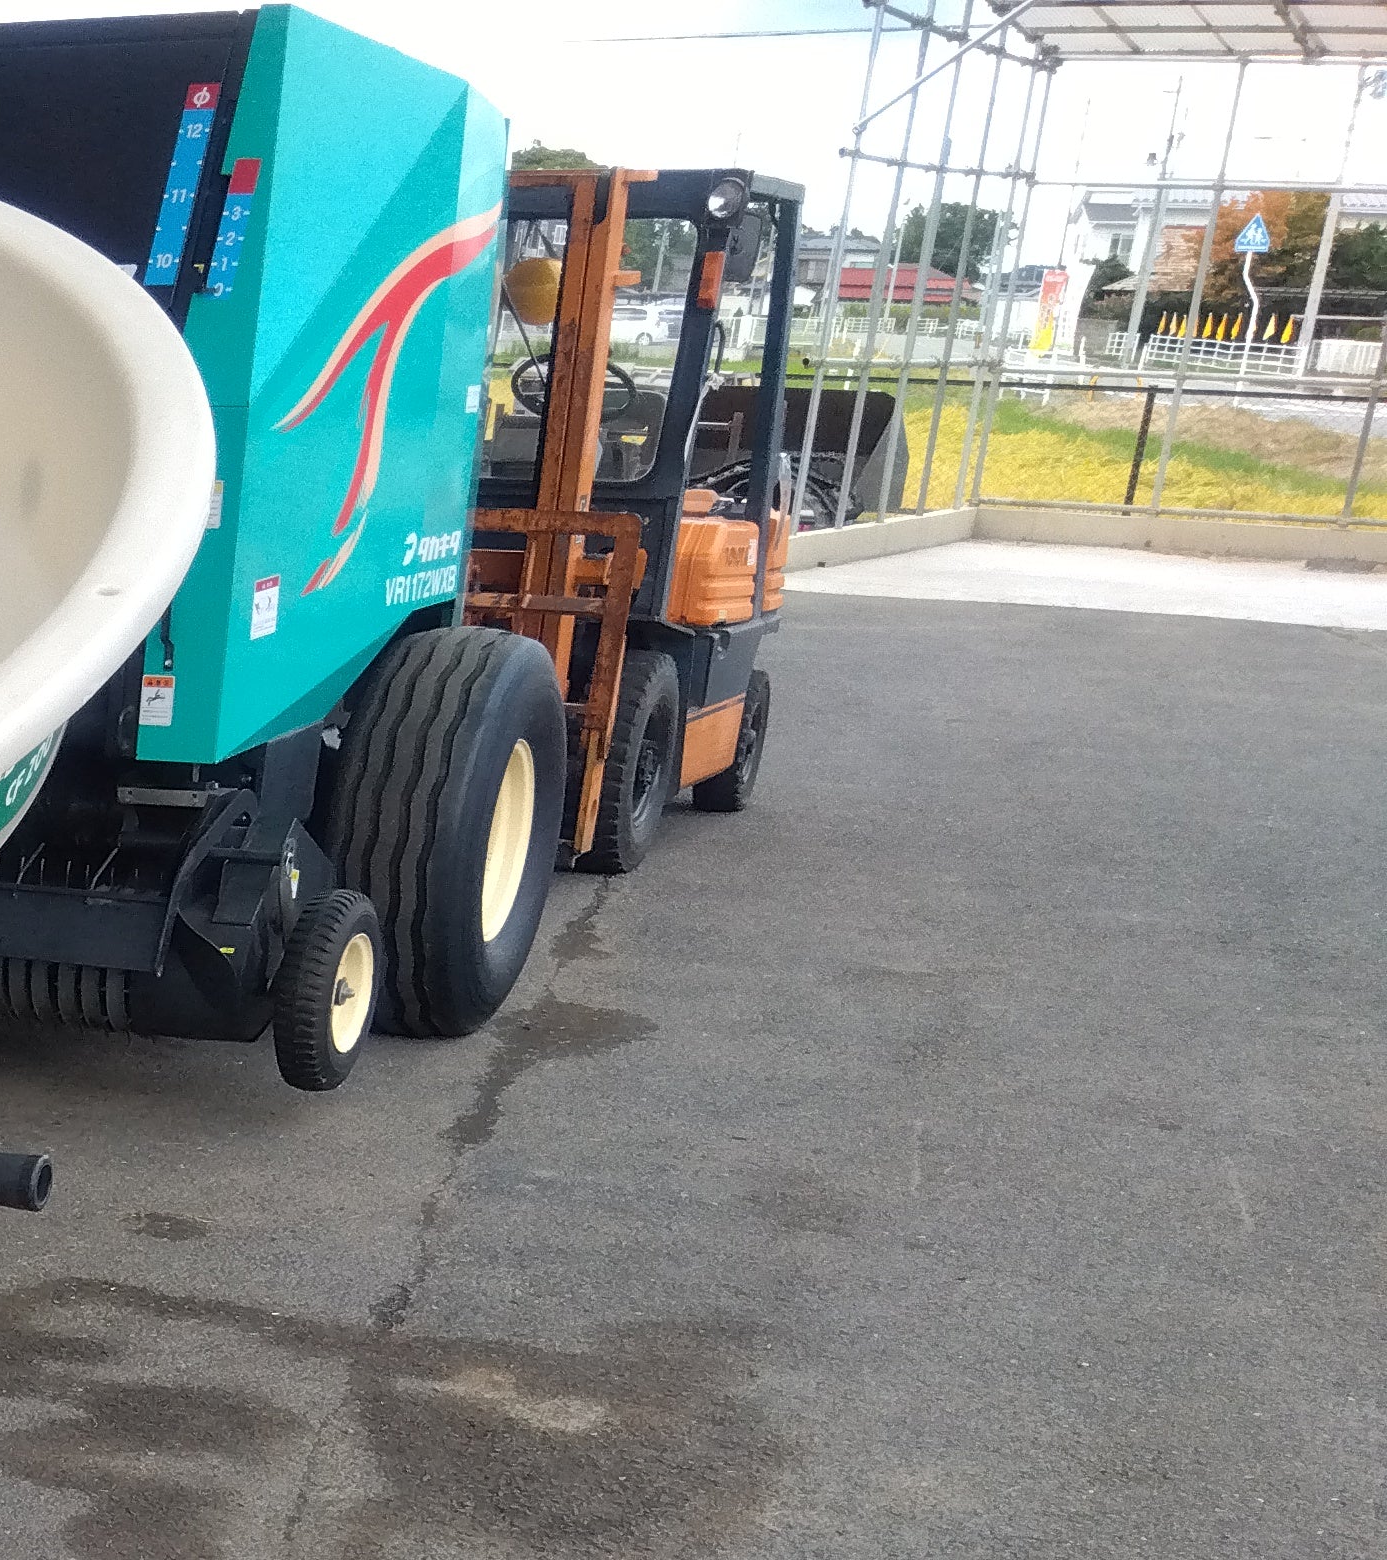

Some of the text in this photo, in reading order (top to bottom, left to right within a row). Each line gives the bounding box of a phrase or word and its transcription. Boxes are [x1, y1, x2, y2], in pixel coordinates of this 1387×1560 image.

[186, 124, 203, 138] 12
[171, 188, 187, 203] 11
[231, 206, 241, 221] 3
[226, 231, 236, 246] 2
[156, 254, 173, 268] 10
[385, 564, 458, 606] VR1172WXB
